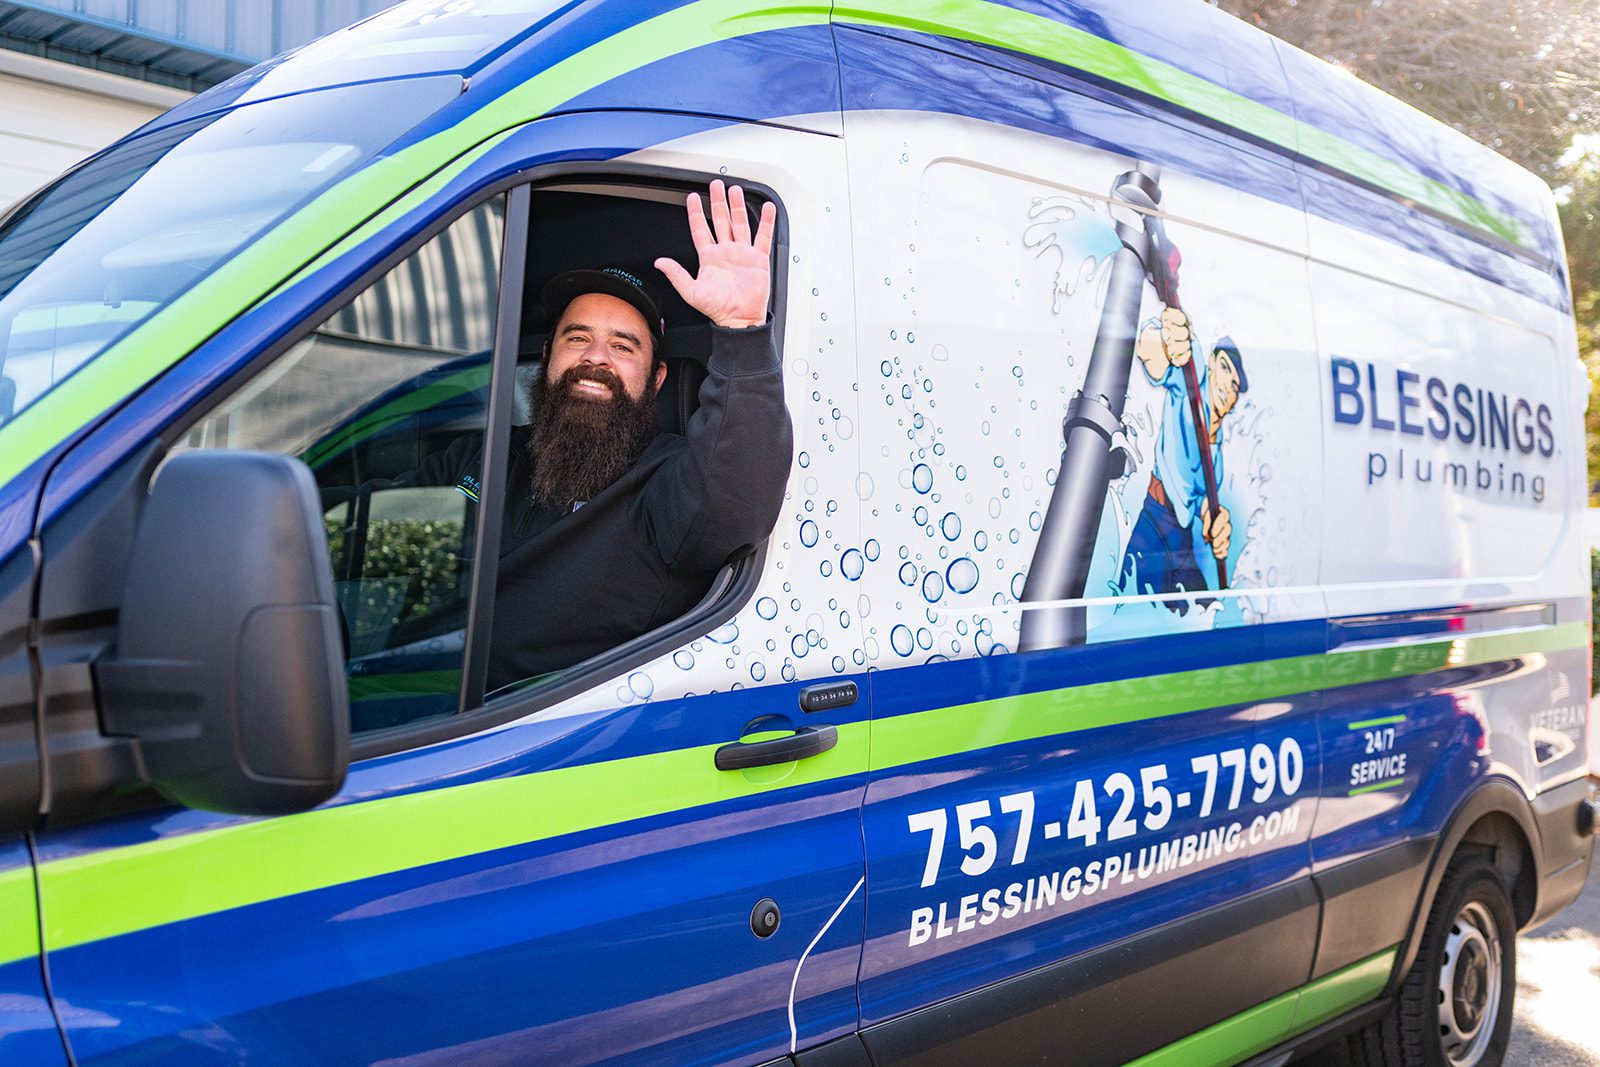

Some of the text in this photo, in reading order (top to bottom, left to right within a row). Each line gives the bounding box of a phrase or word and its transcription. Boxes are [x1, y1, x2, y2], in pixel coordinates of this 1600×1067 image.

[1331, 355, 1555, 458] BLESSINGS
[1368, 448, 1545, 503] plumbing
[1350, 753, 1407, 785] SERVICE
[1364, 728, 1395, 754] 24/7
[908, 737, 1303, 888] 757-425-7790
[908, 806, 1300, 947] BLESSINGSPLUMBING.COM
